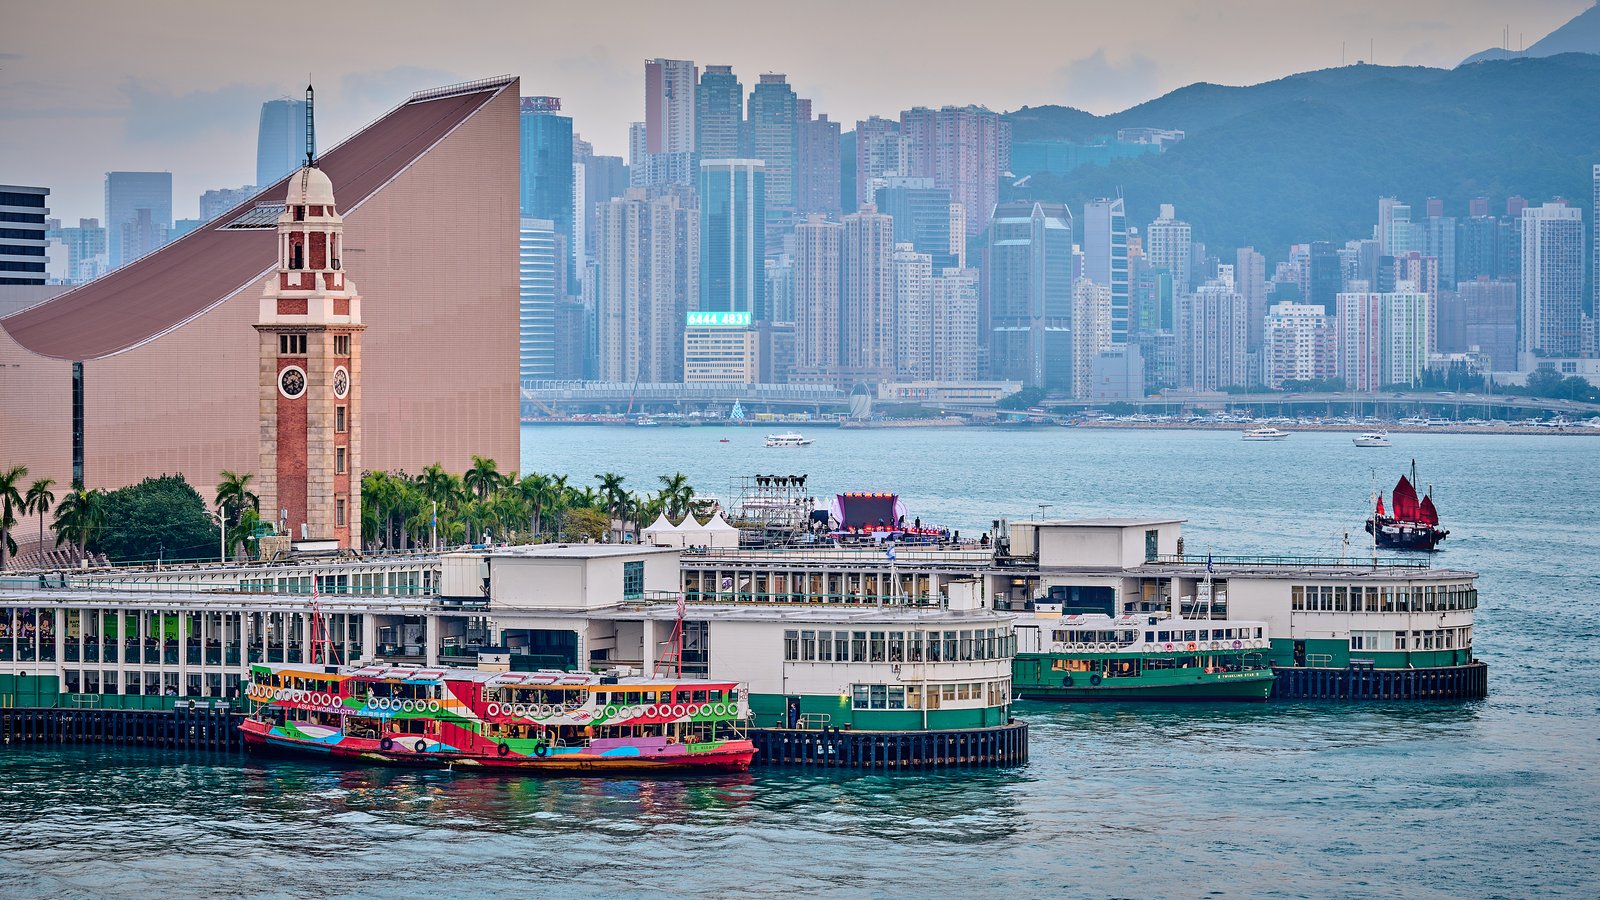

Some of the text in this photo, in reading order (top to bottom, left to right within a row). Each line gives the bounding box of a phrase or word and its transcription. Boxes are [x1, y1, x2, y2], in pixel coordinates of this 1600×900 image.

[688, 313, 749, 324] 6444 4831
[296, 703, 317, 711] ASIA'S
[317, 706, 339, 714] WORLD
